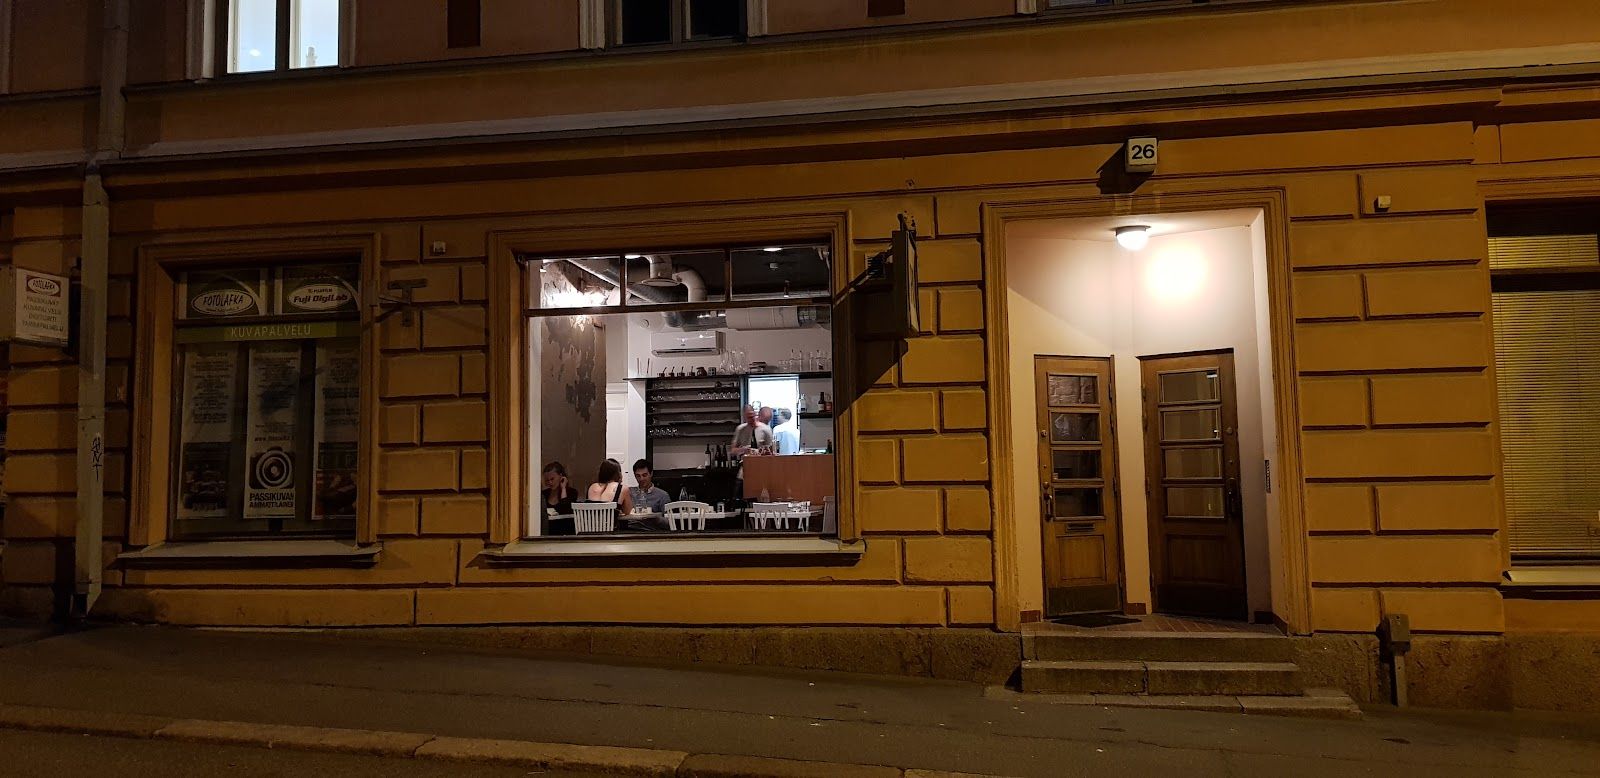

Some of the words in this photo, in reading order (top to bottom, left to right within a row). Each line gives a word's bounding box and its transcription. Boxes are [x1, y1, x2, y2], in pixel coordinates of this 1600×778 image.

[1131, 144, 1155, 159] 26
[203, 294, 243, 306] FOTOLAFKA
[293, 295, 310, 303] Fuji
[312, 294, 348, 303] DigiLab
[231, 324, 311, 337] KUVAPALVELU
